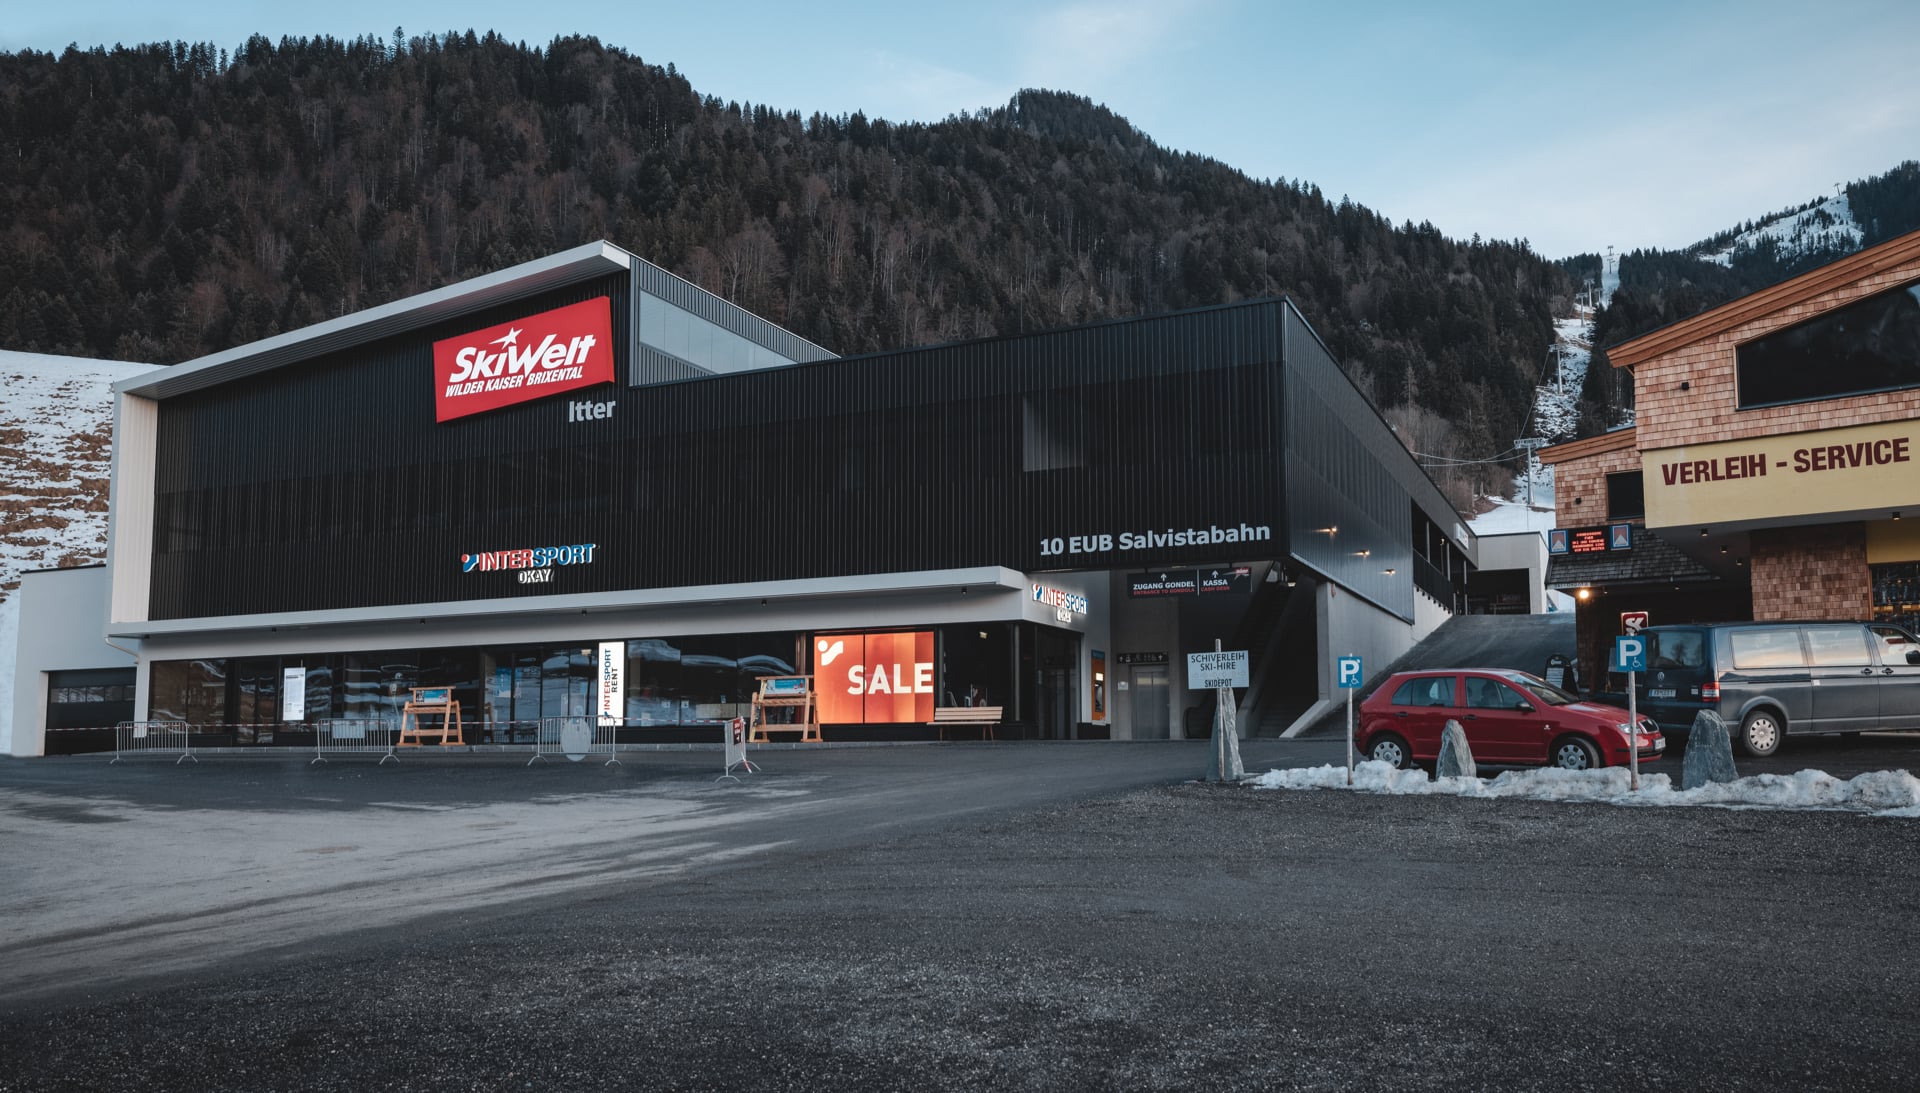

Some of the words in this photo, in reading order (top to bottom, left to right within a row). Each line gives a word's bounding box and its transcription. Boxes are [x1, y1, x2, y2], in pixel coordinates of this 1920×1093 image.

[449, 333, 596, 382] SkiWelt
[445, 379, 485, 397] WILDER
[485, 375, 524, 392] KAISER
[526, 366, 583, 386] BRIXENTAL
[568, 400, 616, 423] Itter
[1661, 453, 1767, 486] VERLEIH
[1794, 437, 1910, 474] SERVICE
[1040, 538, 1064, 556] 10
[1069, 534, 1113, 554] EUB
[1119, 523, 1271, 550] Salvistabahn
[479, 544, 595, 571] INTERSPORT
[518, 569, 553, 584] OKAY
[1042, 586, 1089, 615] INTERSPORT
[1191, 652, 1245, 663] SCHIVERLEIH
[1200, 661, 1236, 671] SKI-HIRE
[1620, 640, 1642, 666] P
[603, 648, 611, 710] INTERSPORT
[848, 662, 933, 695] SALE
[1204, 679, 1232, 688] SKIDEPOT
[1341, 660, 1359, 684] P
